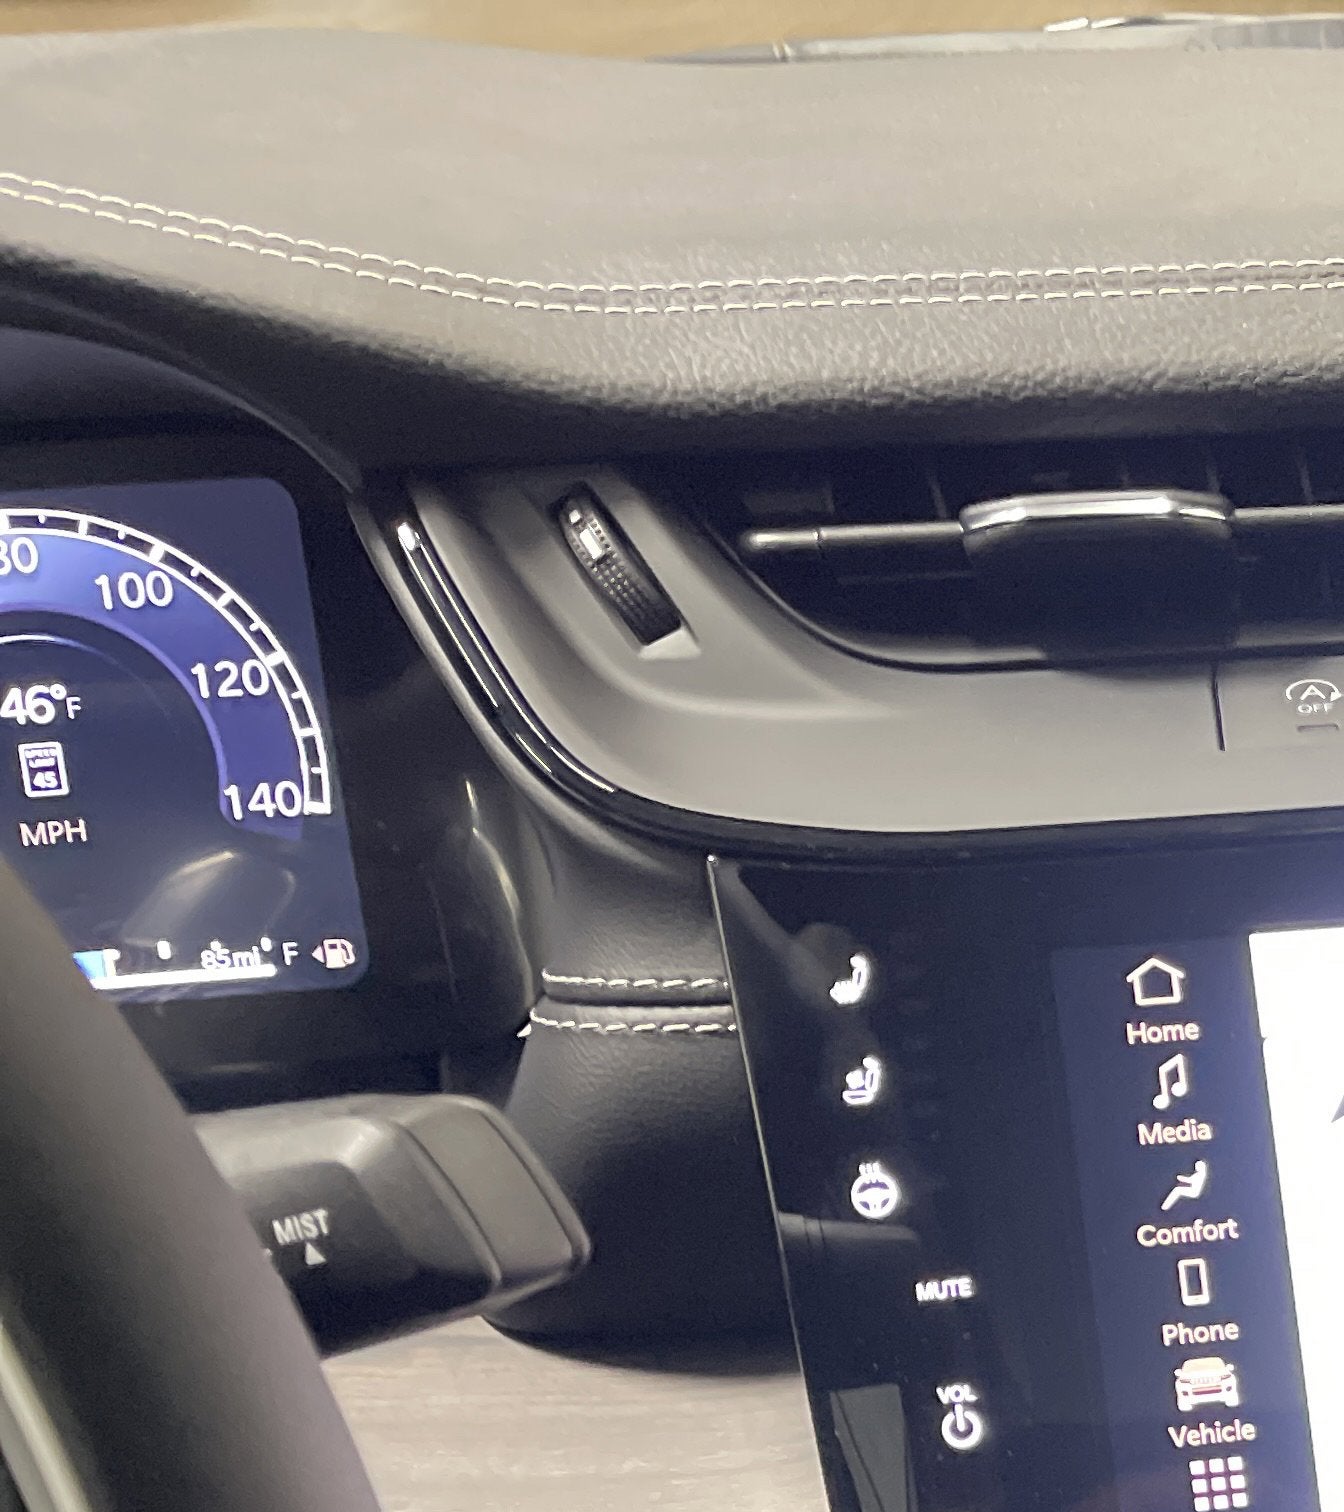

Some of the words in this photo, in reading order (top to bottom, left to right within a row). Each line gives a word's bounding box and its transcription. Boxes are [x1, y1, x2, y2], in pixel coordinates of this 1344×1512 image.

[95, 571, 173, 610] 100
[192, 660, 270, 699] 120
[224, 781, 302, 820] 140
[19, 819, 87, 847] MPH
[282, 941, 299, 966] F
[1126, 1021, 1199, 1044] Home
[1138, 1119, 1213, 1146] Media
[271, 1207, 329, 1246] MIST
[1137, 1218, 1240, 1247] Comfort
[916, 1275, 973, 1302] MUTE
[1162, 1320, 1240, 1347] Phone
[936, 1384, 978, 1405] VOL
[1168, 1418, 1256, 1448] Vehicle
